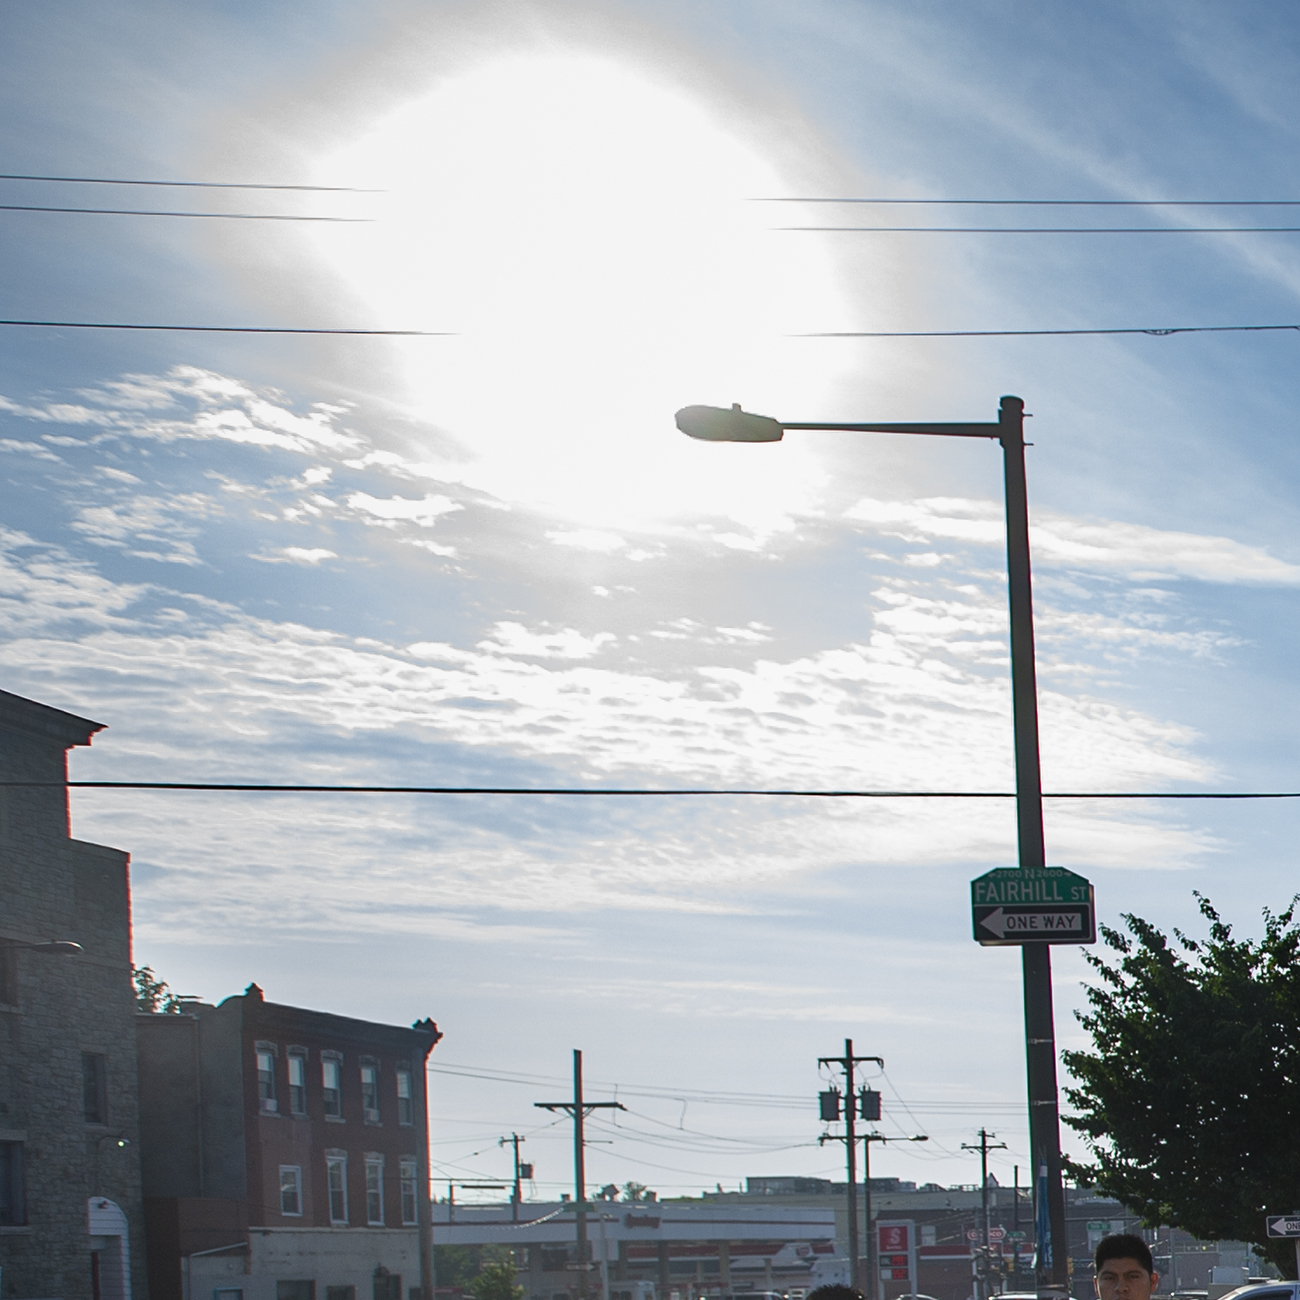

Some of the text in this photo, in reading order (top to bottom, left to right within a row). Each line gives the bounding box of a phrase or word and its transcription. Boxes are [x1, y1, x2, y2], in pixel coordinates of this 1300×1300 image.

[997, 869, 1062, 879] 2700 N 2600
[974, 880, 1086, 902] FAIRHILL ST
[1006, 915, 1076, 930] ONE WAY
